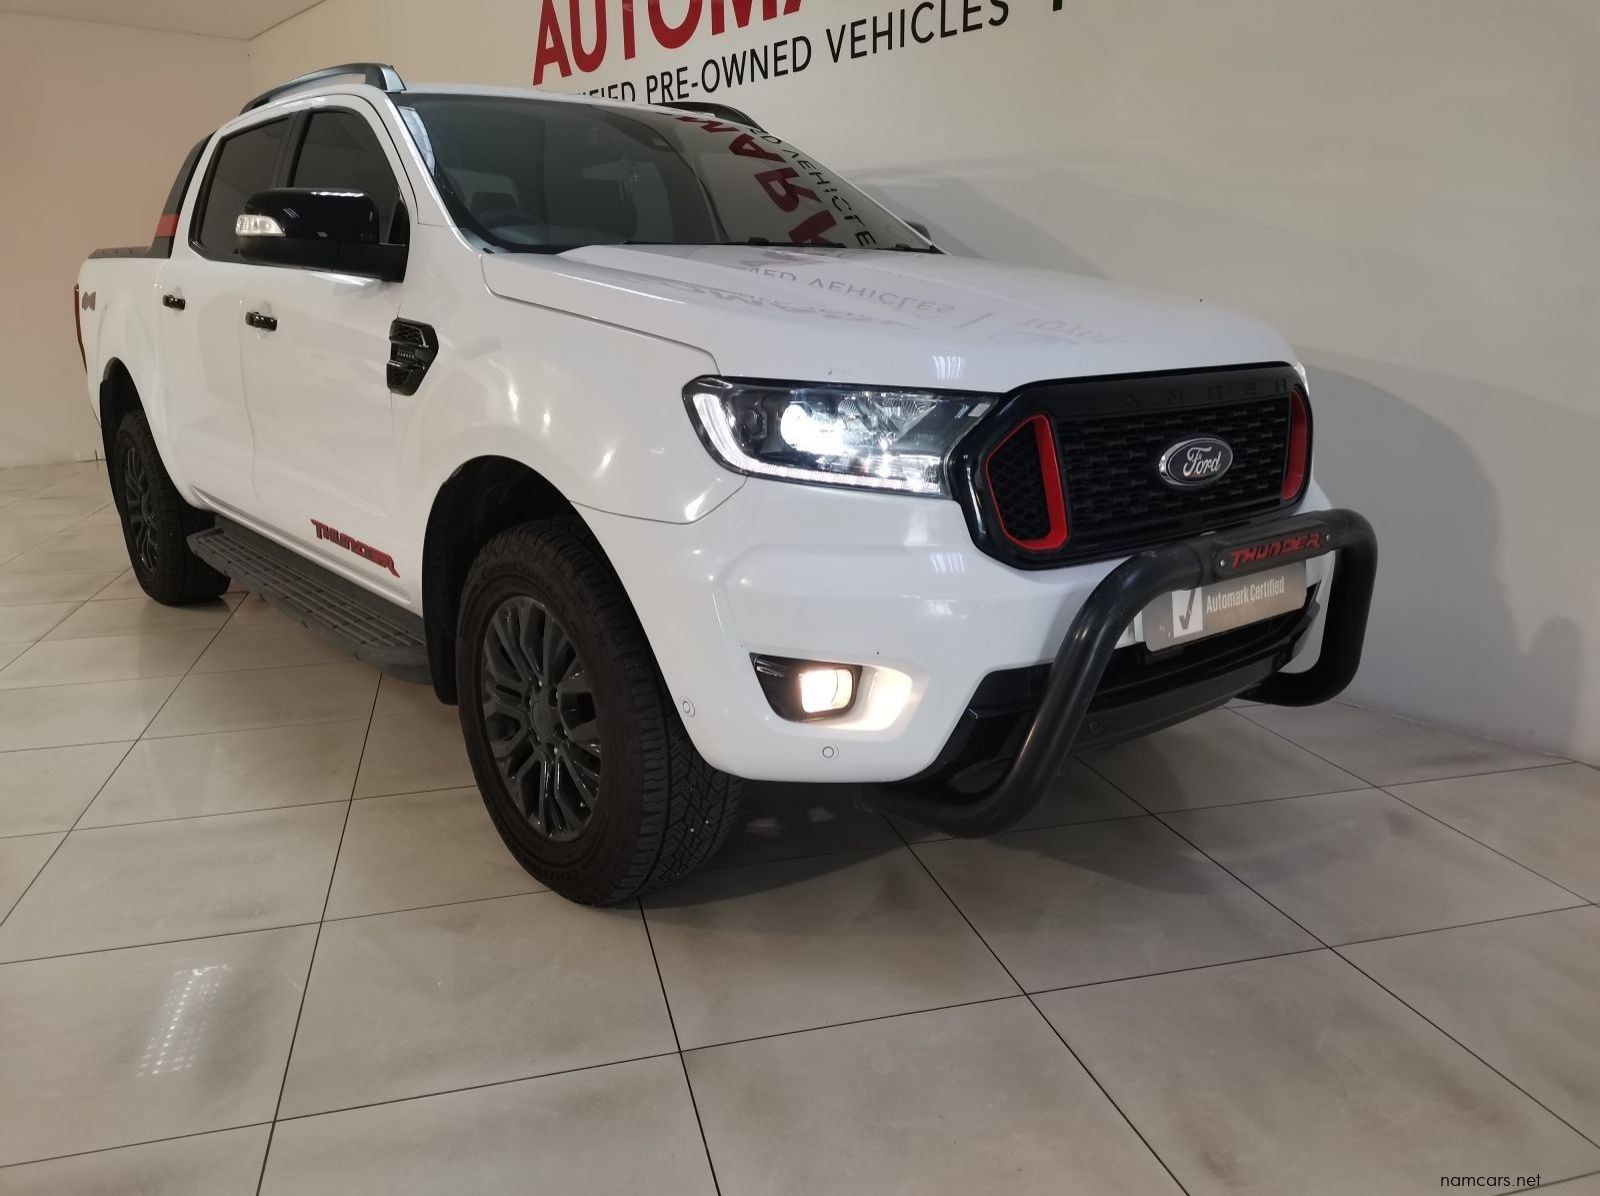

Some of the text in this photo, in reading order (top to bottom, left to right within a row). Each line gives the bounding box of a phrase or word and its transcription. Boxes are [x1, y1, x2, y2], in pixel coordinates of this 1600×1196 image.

[646, 36, 812, 105] PRE-OWNED
[825, 0, 1009, 64] VEHICLES
[1183, 446, 1222, 477] Ford
[310, 518, 401, 579] THUNDER
[1231, 531, 1322, 570] THUNDER
[1206, 576, 1286, 614] Automark Certified
